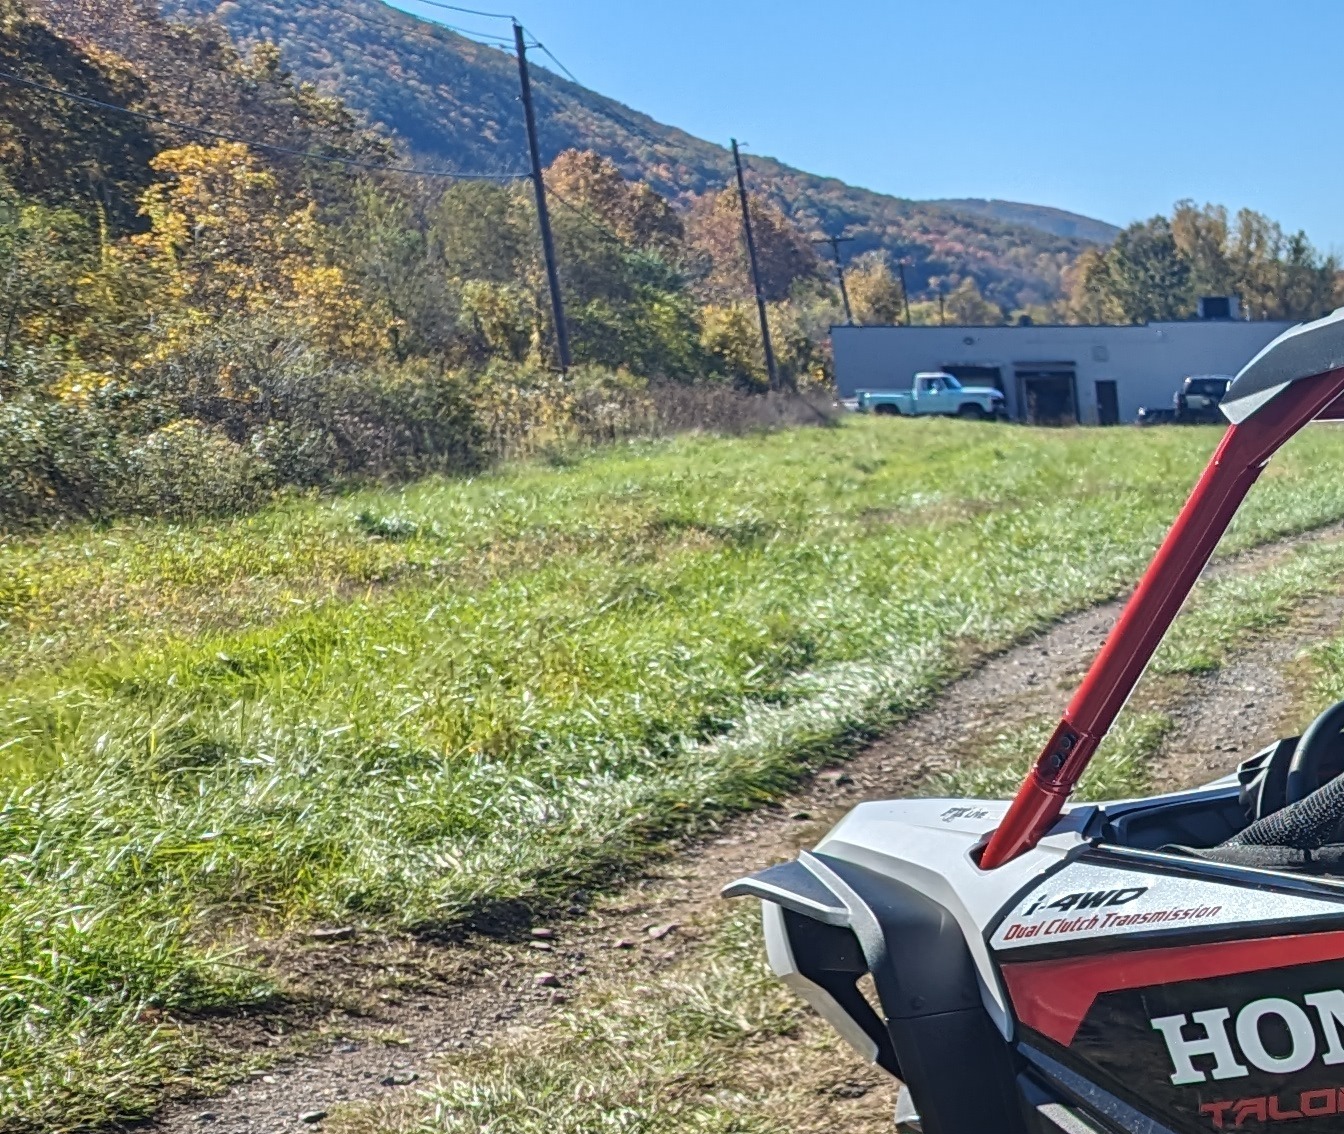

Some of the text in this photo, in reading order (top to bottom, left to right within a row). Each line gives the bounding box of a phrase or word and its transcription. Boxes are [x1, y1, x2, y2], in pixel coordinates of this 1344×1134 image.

[1022, 887, 1148, 917] i-4WD
[1003, 904, 1223, 941] Dual Clutch Transmission
